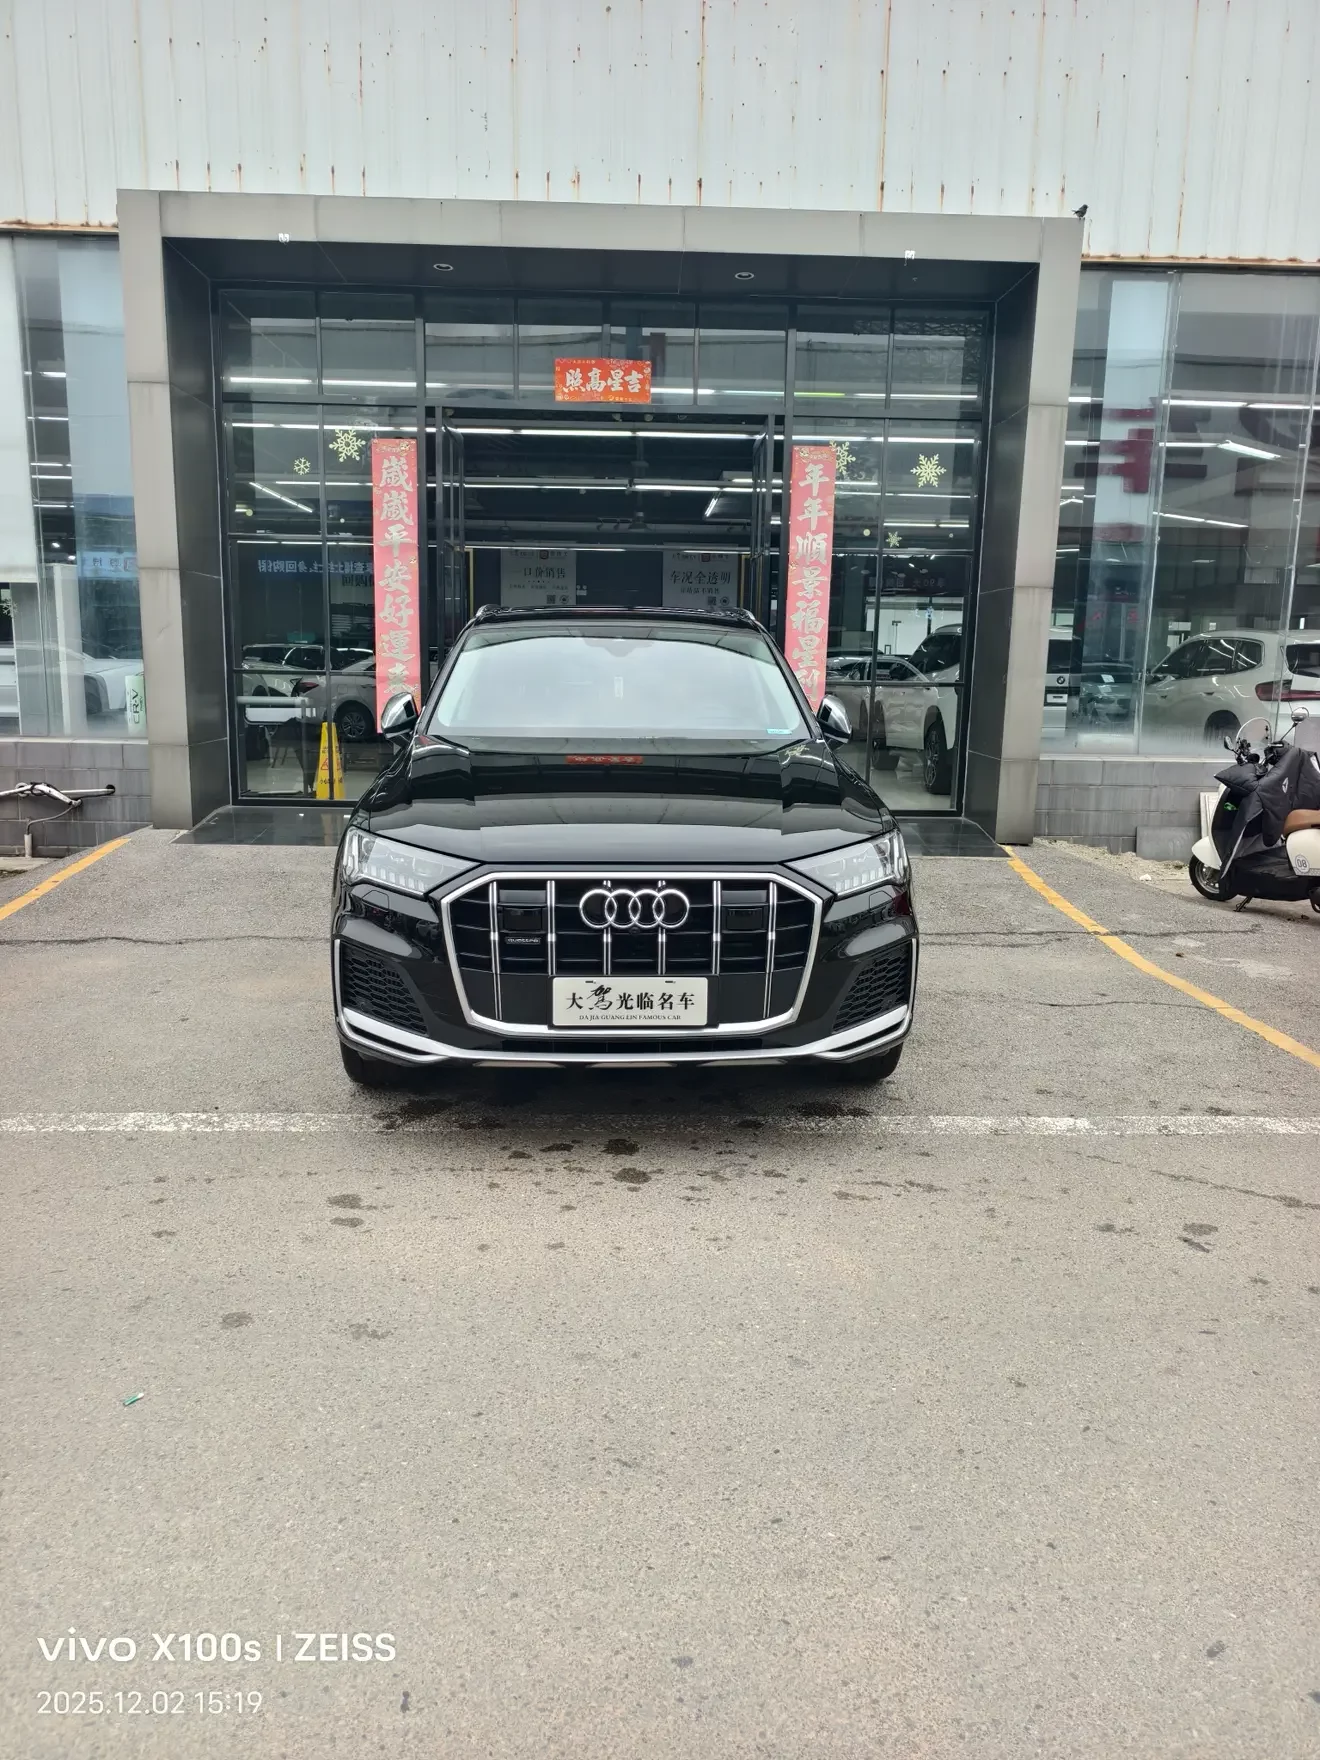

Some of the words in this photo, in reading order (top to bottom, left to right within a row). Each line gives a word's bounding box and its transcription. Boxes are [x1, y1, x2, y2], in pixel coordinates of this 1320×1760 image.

[670, 570, 731, 585] 车况全透明
